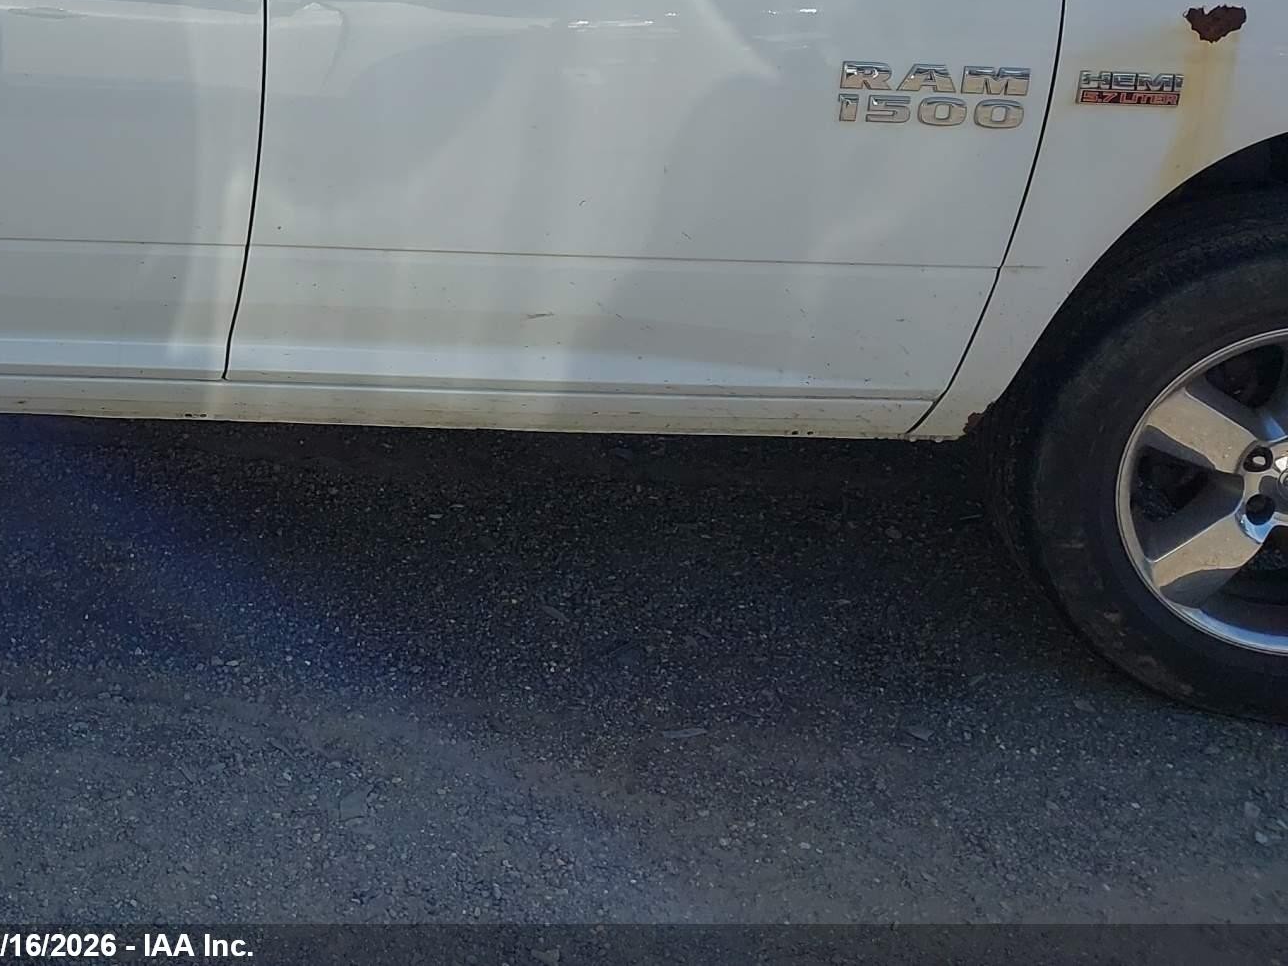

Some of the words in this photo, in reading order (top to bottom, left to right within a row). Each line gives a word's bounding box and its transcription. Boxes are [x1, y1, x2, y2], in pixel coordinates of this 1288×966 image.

[840, 61, 1031, 96] RAM
[1079, 71, 1184, 92] HEMI
[838, 94, 1025, 128] 1500
[1082, 91, 1117, 103] 5.7
[1119, 92, 1178, 105] LITER
